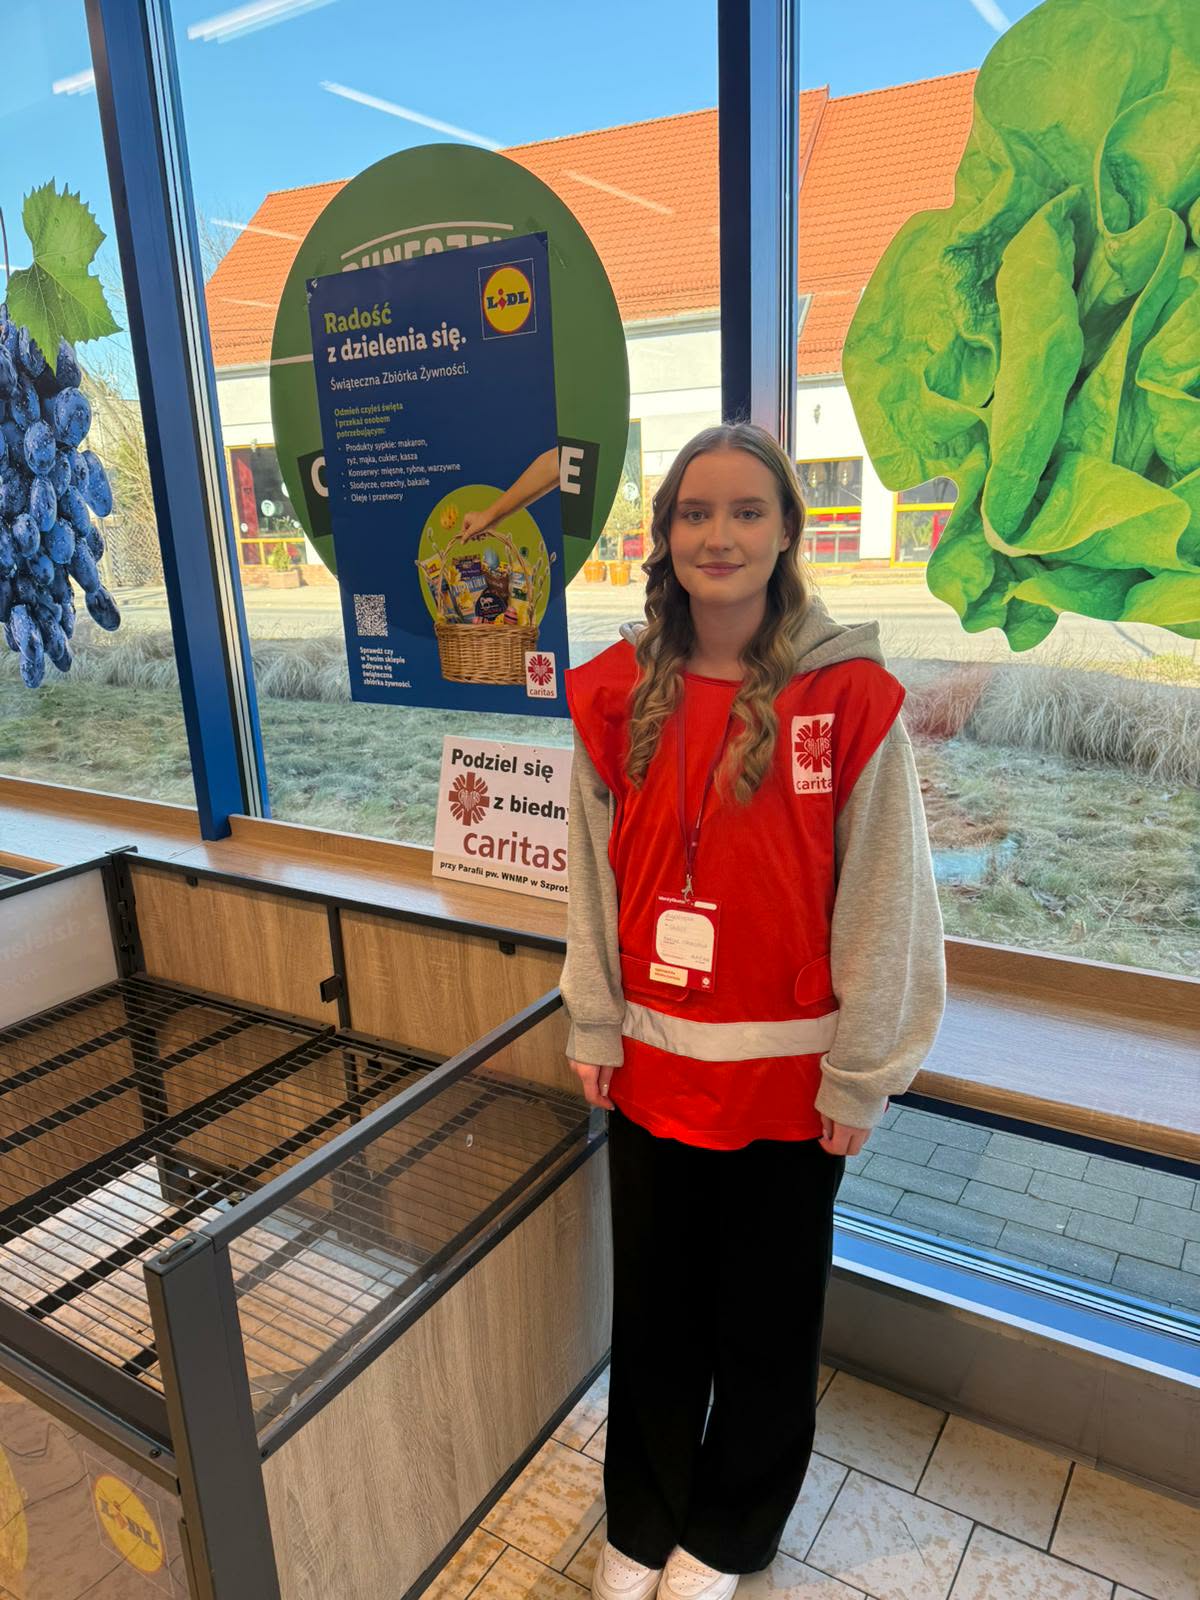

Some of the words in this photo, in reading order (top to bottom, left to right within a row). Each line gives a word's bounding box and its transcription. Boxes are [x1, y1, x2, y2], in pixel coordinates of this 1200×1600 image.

[323, 302, 392, 334] Radość
[327, 347, 337, 363] z
[340, 326, 428, 361] dzielenia
[431, 321, 467, 351] się.
[330, 376, 380, 392] Świąteczna
[382, 368, 417, 384] Zbiórka
[419, 362, 469, 382] Żywności.
[334, 406, 360, 416] Odmień
[360, 403, 381, 415] czyjeś
[381, 401, 404, 412] święta
[364, 414, 391, 424] osobom
[345, 441, 374, 453] Produkty
[374, 440, 397, 451] sypkie:
[397, 438, 428, 449] makaron,
[347, 455, 358, 466] ryż,
[359, 454, 378, 465] mąka,
[378, 452, 399, 463] cukier,
[400, 451, 418, 461] kasza
[348, 466, 380, 478] Konserwy:
[380, 466, 406, 476] mięsne,
[406, 464, 427, 475] rybne,
[427, 463, 461, 473] warzywne
[349, 479, 379, 490] Słodycze,
[379, 477, 407, 489] orzechy,
[406, 475, 430, 486] bakalie
[351, 491, 368, 503] Oleje
[372, 490, 404, 503] przetwory
[530, 687, 554, 697] caritas
[451, 748, 518, 774] Podziel
[523, 760, 555, 783] się
[493, 796, 505, 810] z
[463, 831, 568, 873] caritas
[440, 860, 457, 872] przy
[458, 863, 484, 876] Parafii
[485, 868, 500, 880] pw.
[501, 871, 529, 885] WNMP
[530, 878, 539, 887] w
